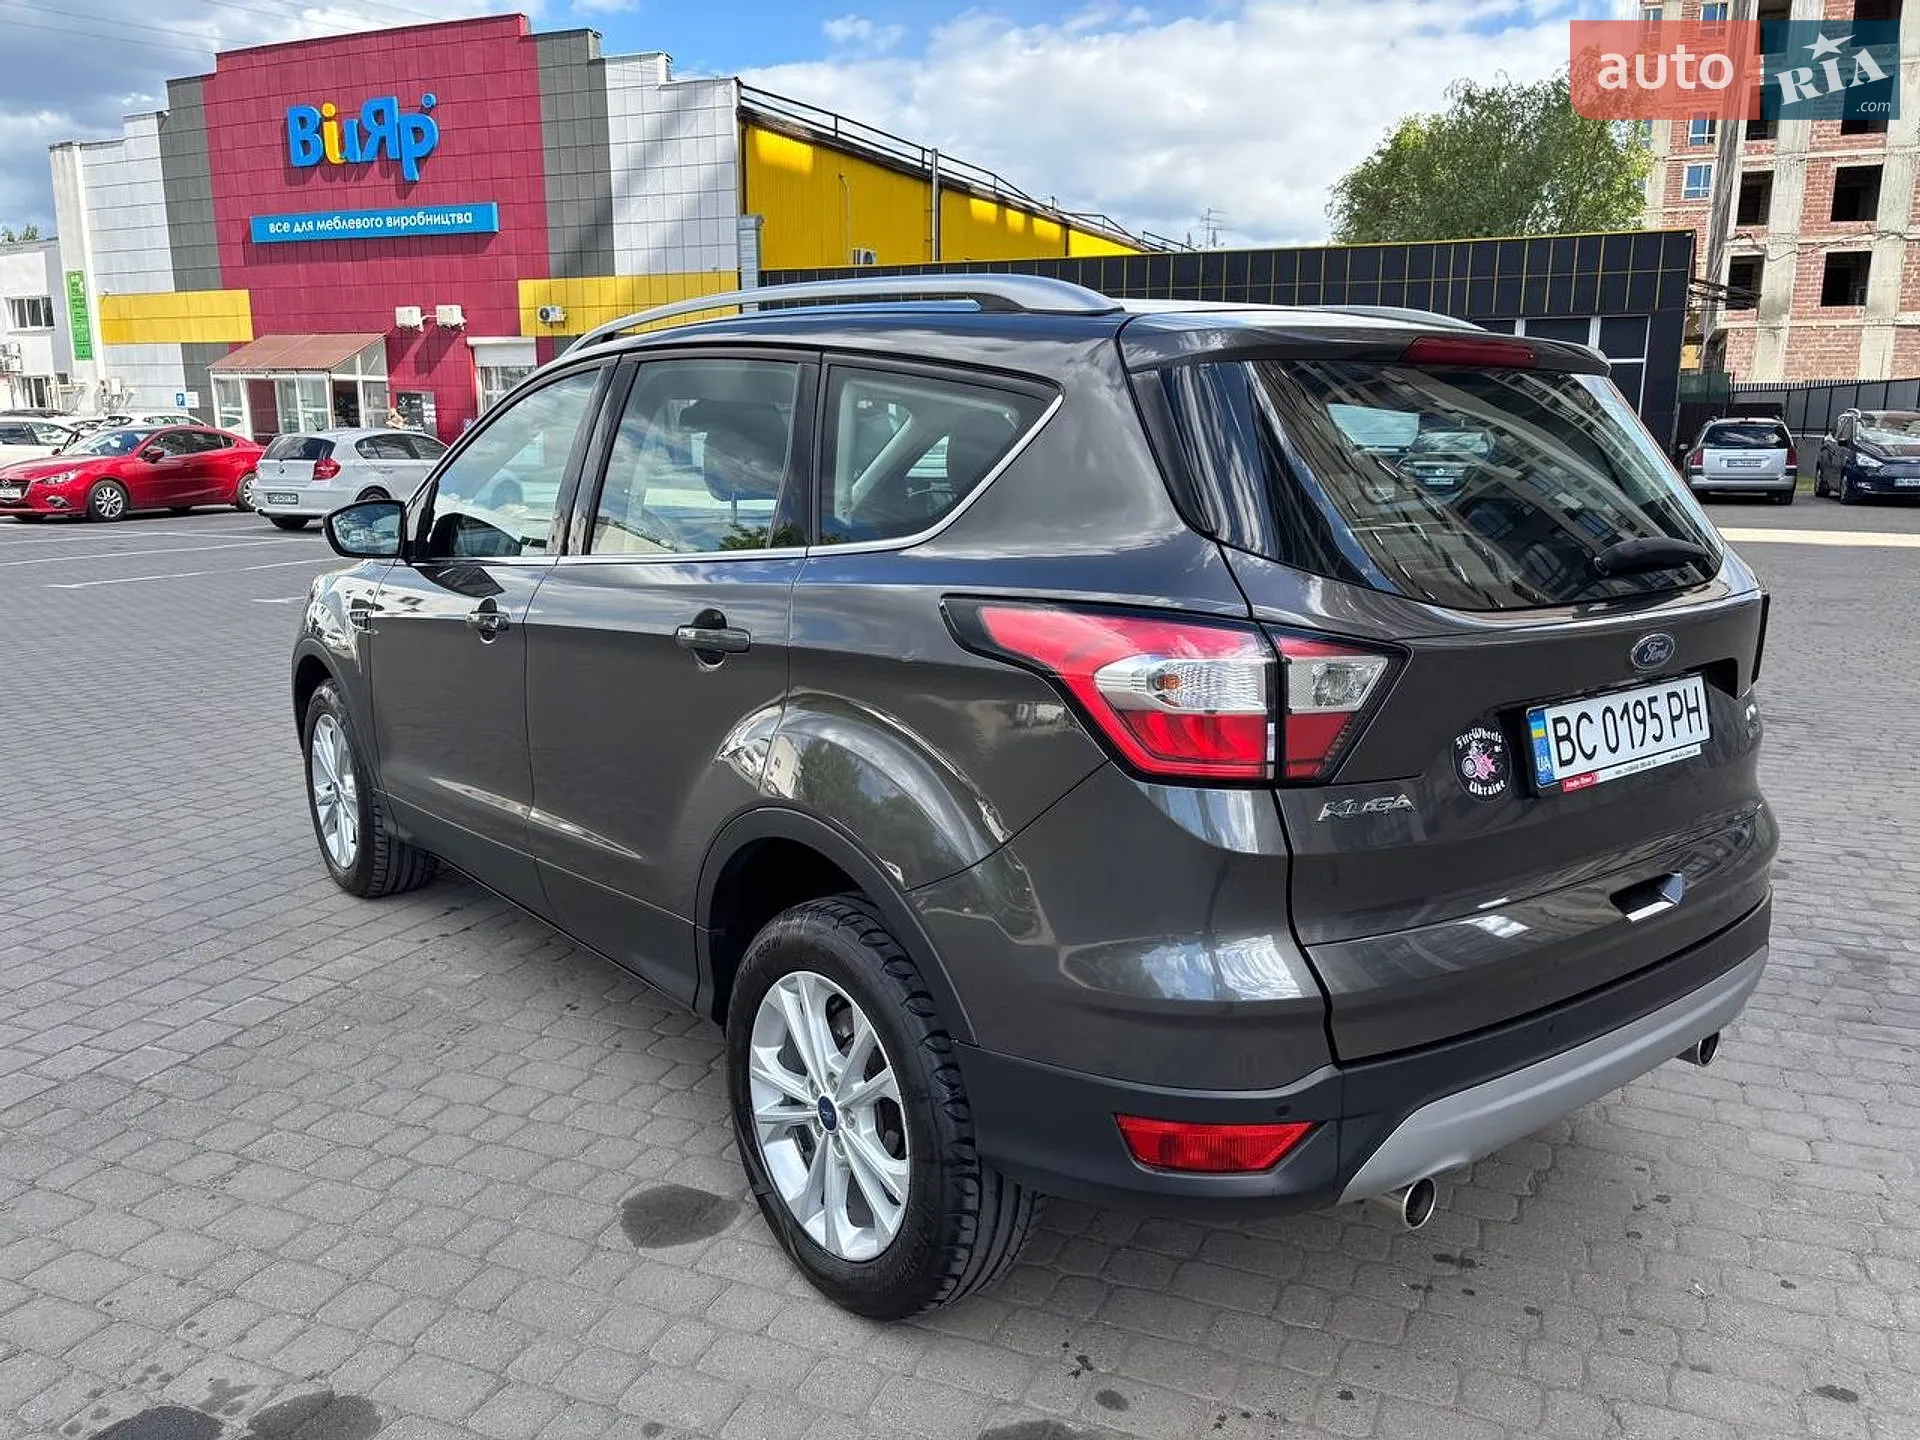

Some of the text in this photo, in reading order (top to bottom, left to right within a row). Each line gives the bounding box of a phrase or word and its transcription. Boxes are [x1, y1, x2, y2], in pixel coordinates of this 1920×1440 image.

[269, 210, 473, 233] все для меблевого виробництва
[1552, 686, 1703, 768] BC 0195 PH
[1469, 780, 1506, 795] Ukraine
